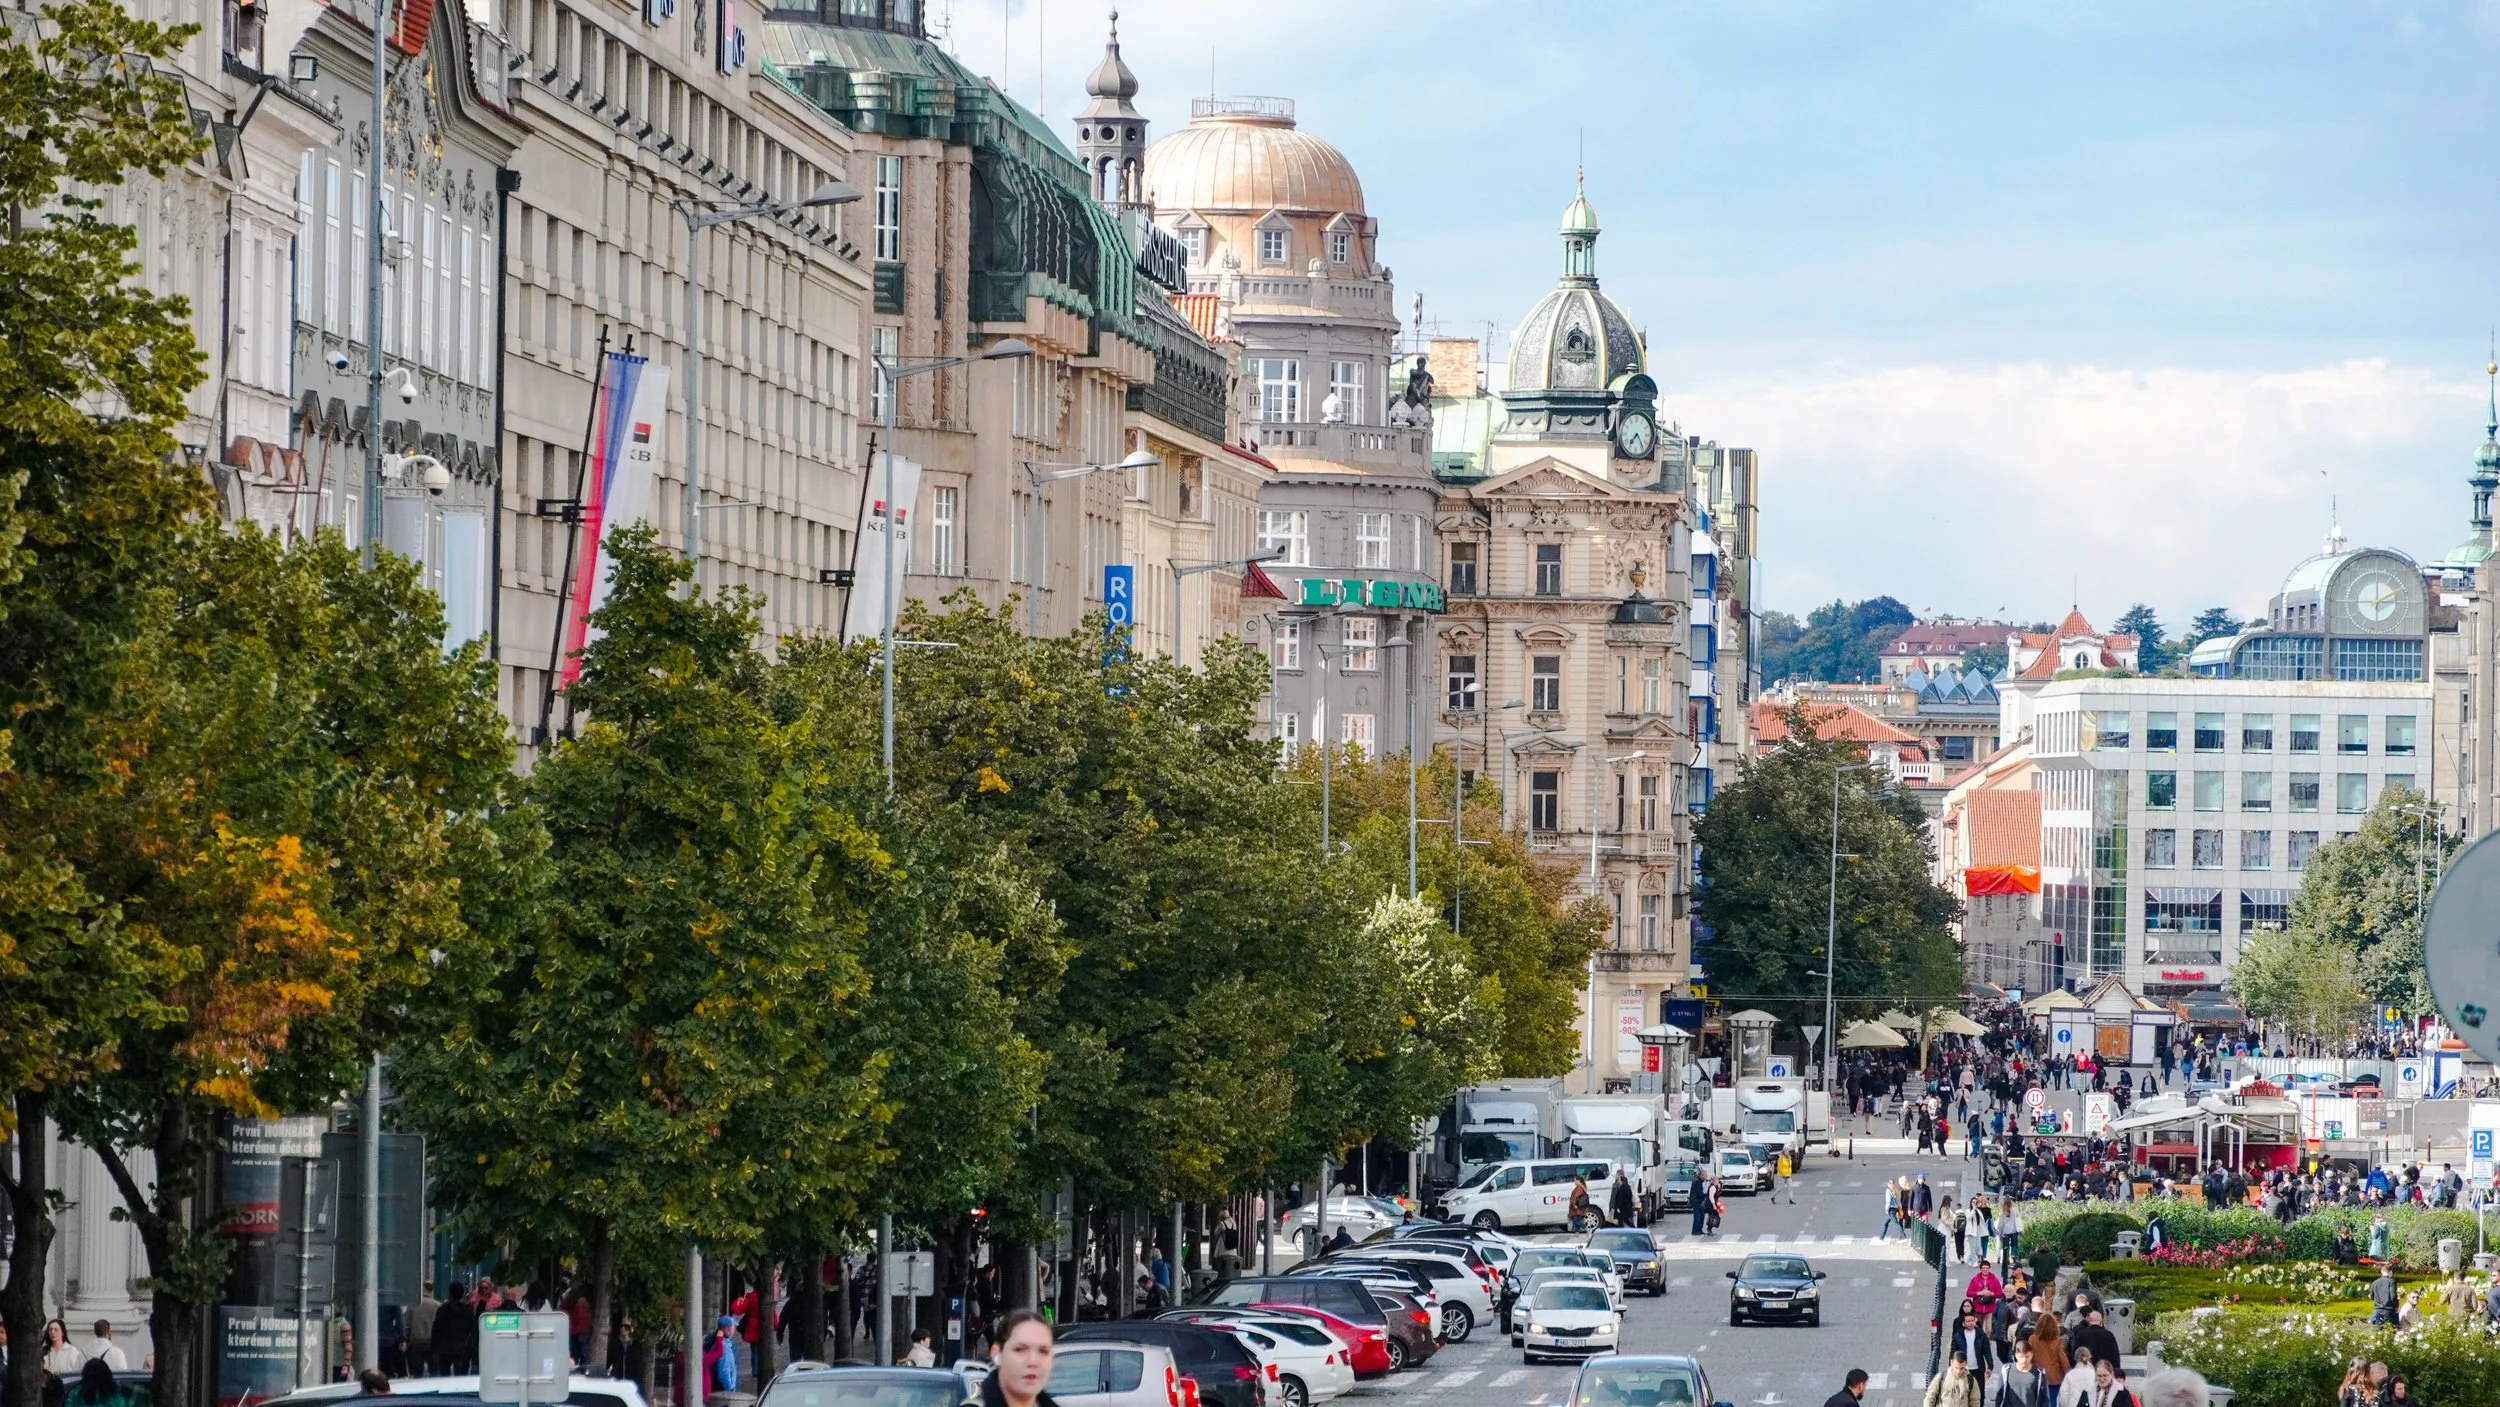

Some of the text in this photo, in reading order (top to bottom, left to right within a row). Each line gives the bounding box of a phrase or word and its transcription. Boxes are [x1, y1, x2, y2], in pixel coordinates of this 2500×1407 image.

[732, 25, 746, 68] KB
[1294, 579, 1445, 613] LIGNA
[1619, 1016, 1640, 1025] -50%
[2234, 1096, 2243, 1106] 11
[2476, 1132, 2489, 1151] P
[951, 1298, 959, 1310] P
[228, 1317, 256, 1330] První
